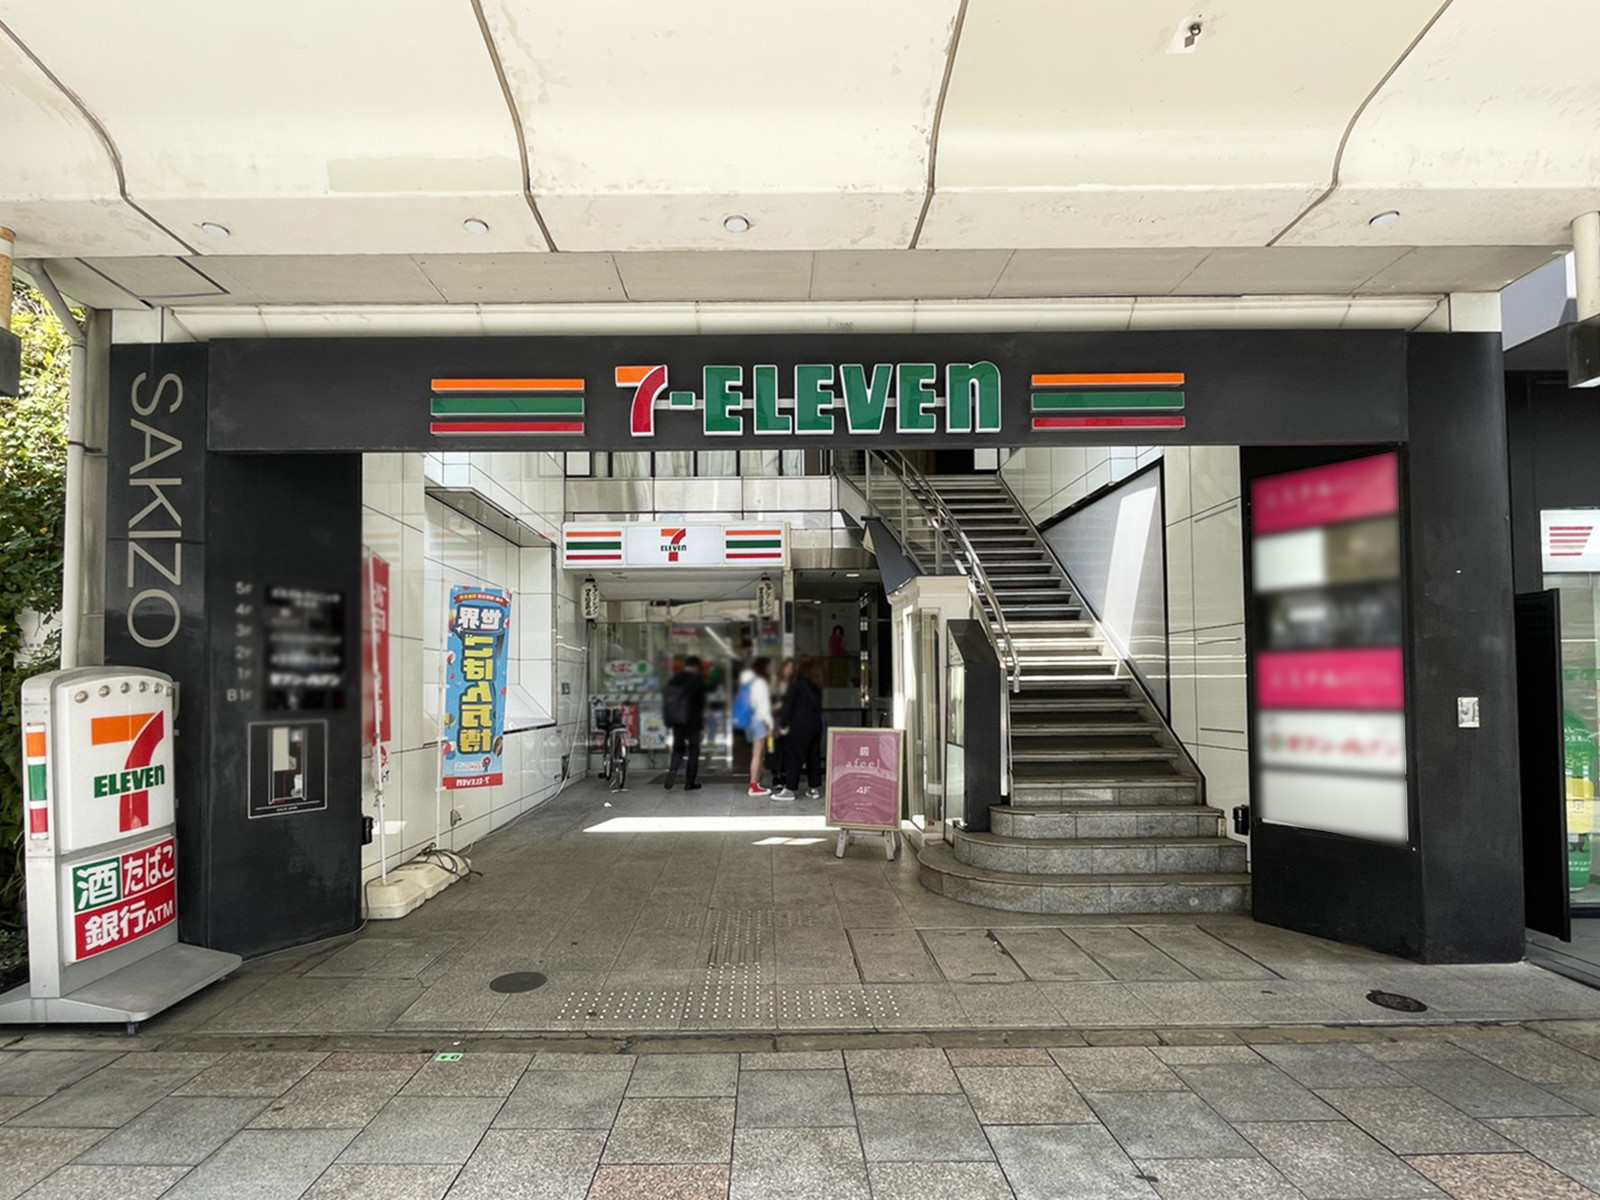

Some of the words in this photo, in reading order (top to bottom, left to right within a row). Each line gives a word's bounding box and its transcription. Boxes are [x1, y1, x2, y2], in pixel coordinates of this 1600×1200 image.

[127, 372, 184, 648] SAKIZO
[660, 528, 686, 562] 7
[91, 710, 164, 832] 7
[94, 764, 165, 798] ELEVEn
[856, 786, 871, 794] 4F
[77, 861, 118, 909] 酒
[123, 845, 174, 895] たばこ
